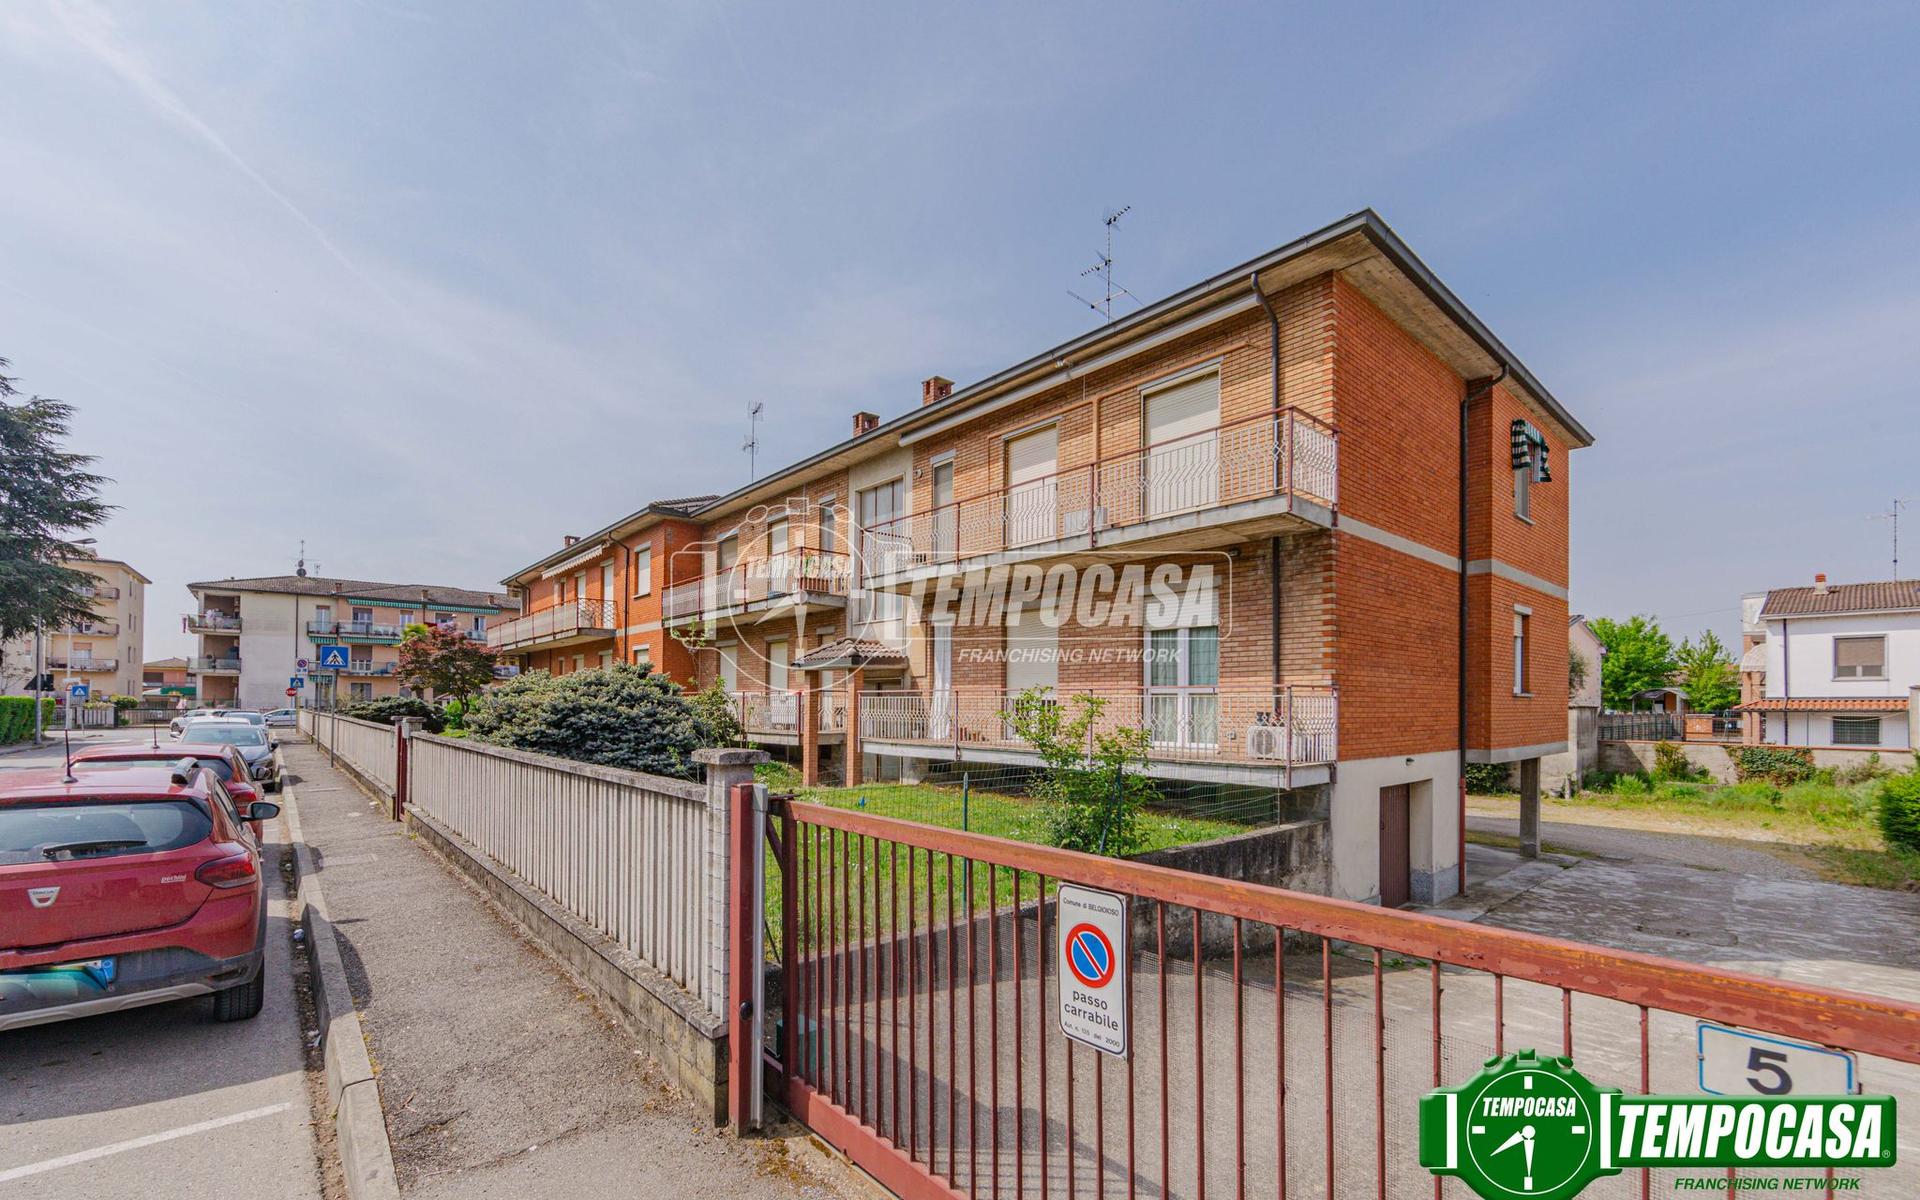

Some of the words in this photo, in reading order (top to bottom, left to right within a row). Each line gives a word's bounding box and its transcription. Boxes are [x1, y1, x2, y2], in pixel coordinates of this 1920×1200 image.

[1063, 897, 1081, 907] Comune
[1073, 990, 1108, 1010] passo
[1064, 1003, 1119, 1031] carrabile
[1746, 1047, 1792, 1095] 5
